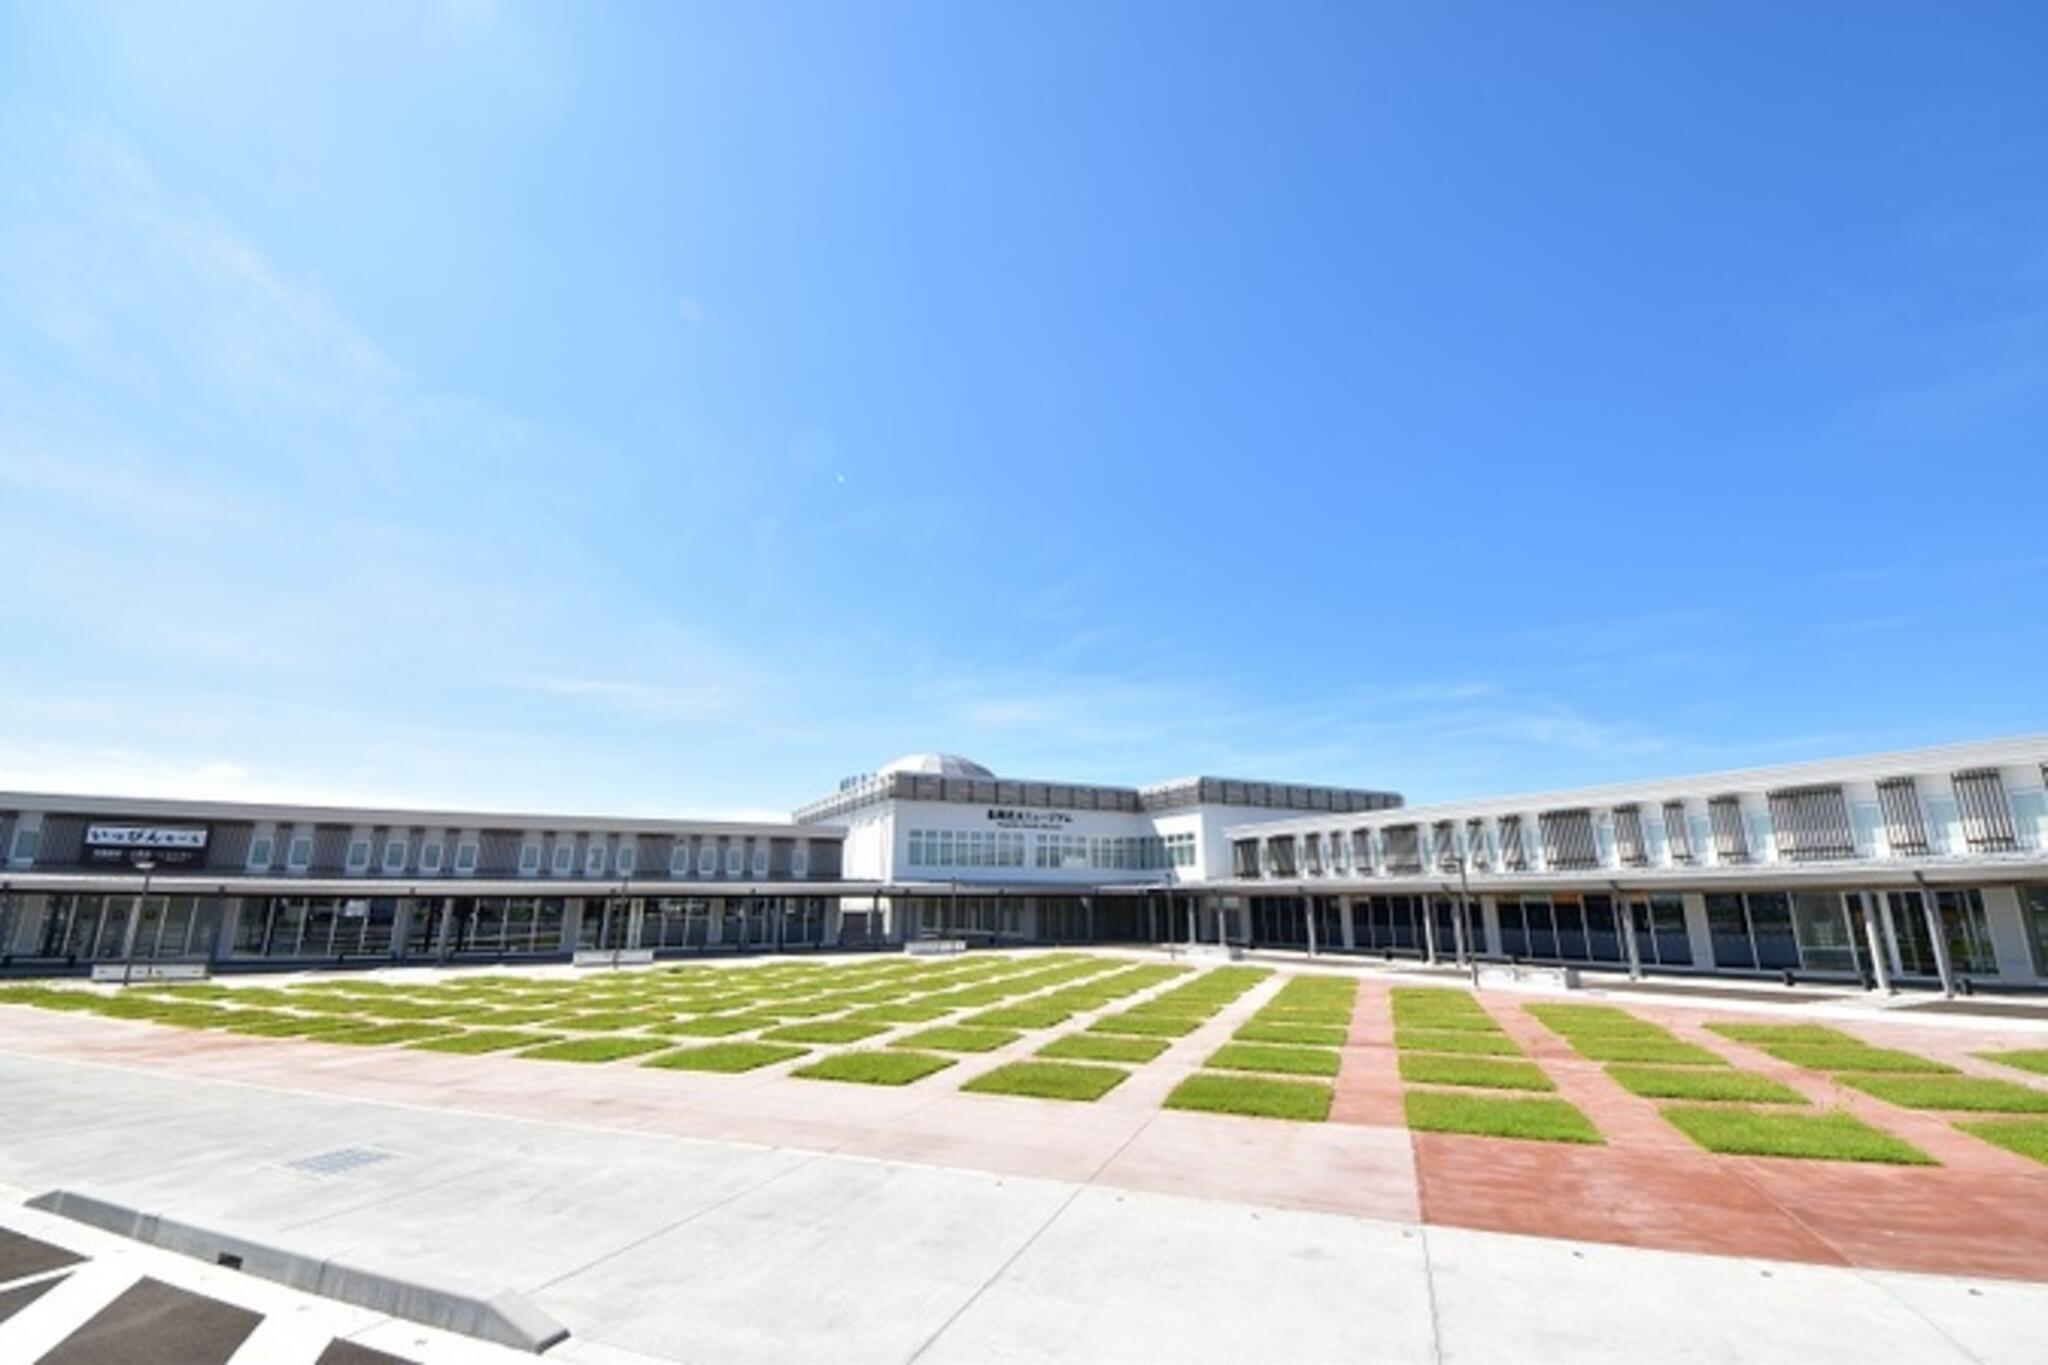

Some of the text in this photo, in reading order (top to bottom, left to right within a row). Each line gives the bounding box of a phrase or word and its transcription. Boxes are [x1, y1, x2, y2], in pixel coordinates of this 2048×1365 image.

[988, 809, 1073, 823] ミュージアム
